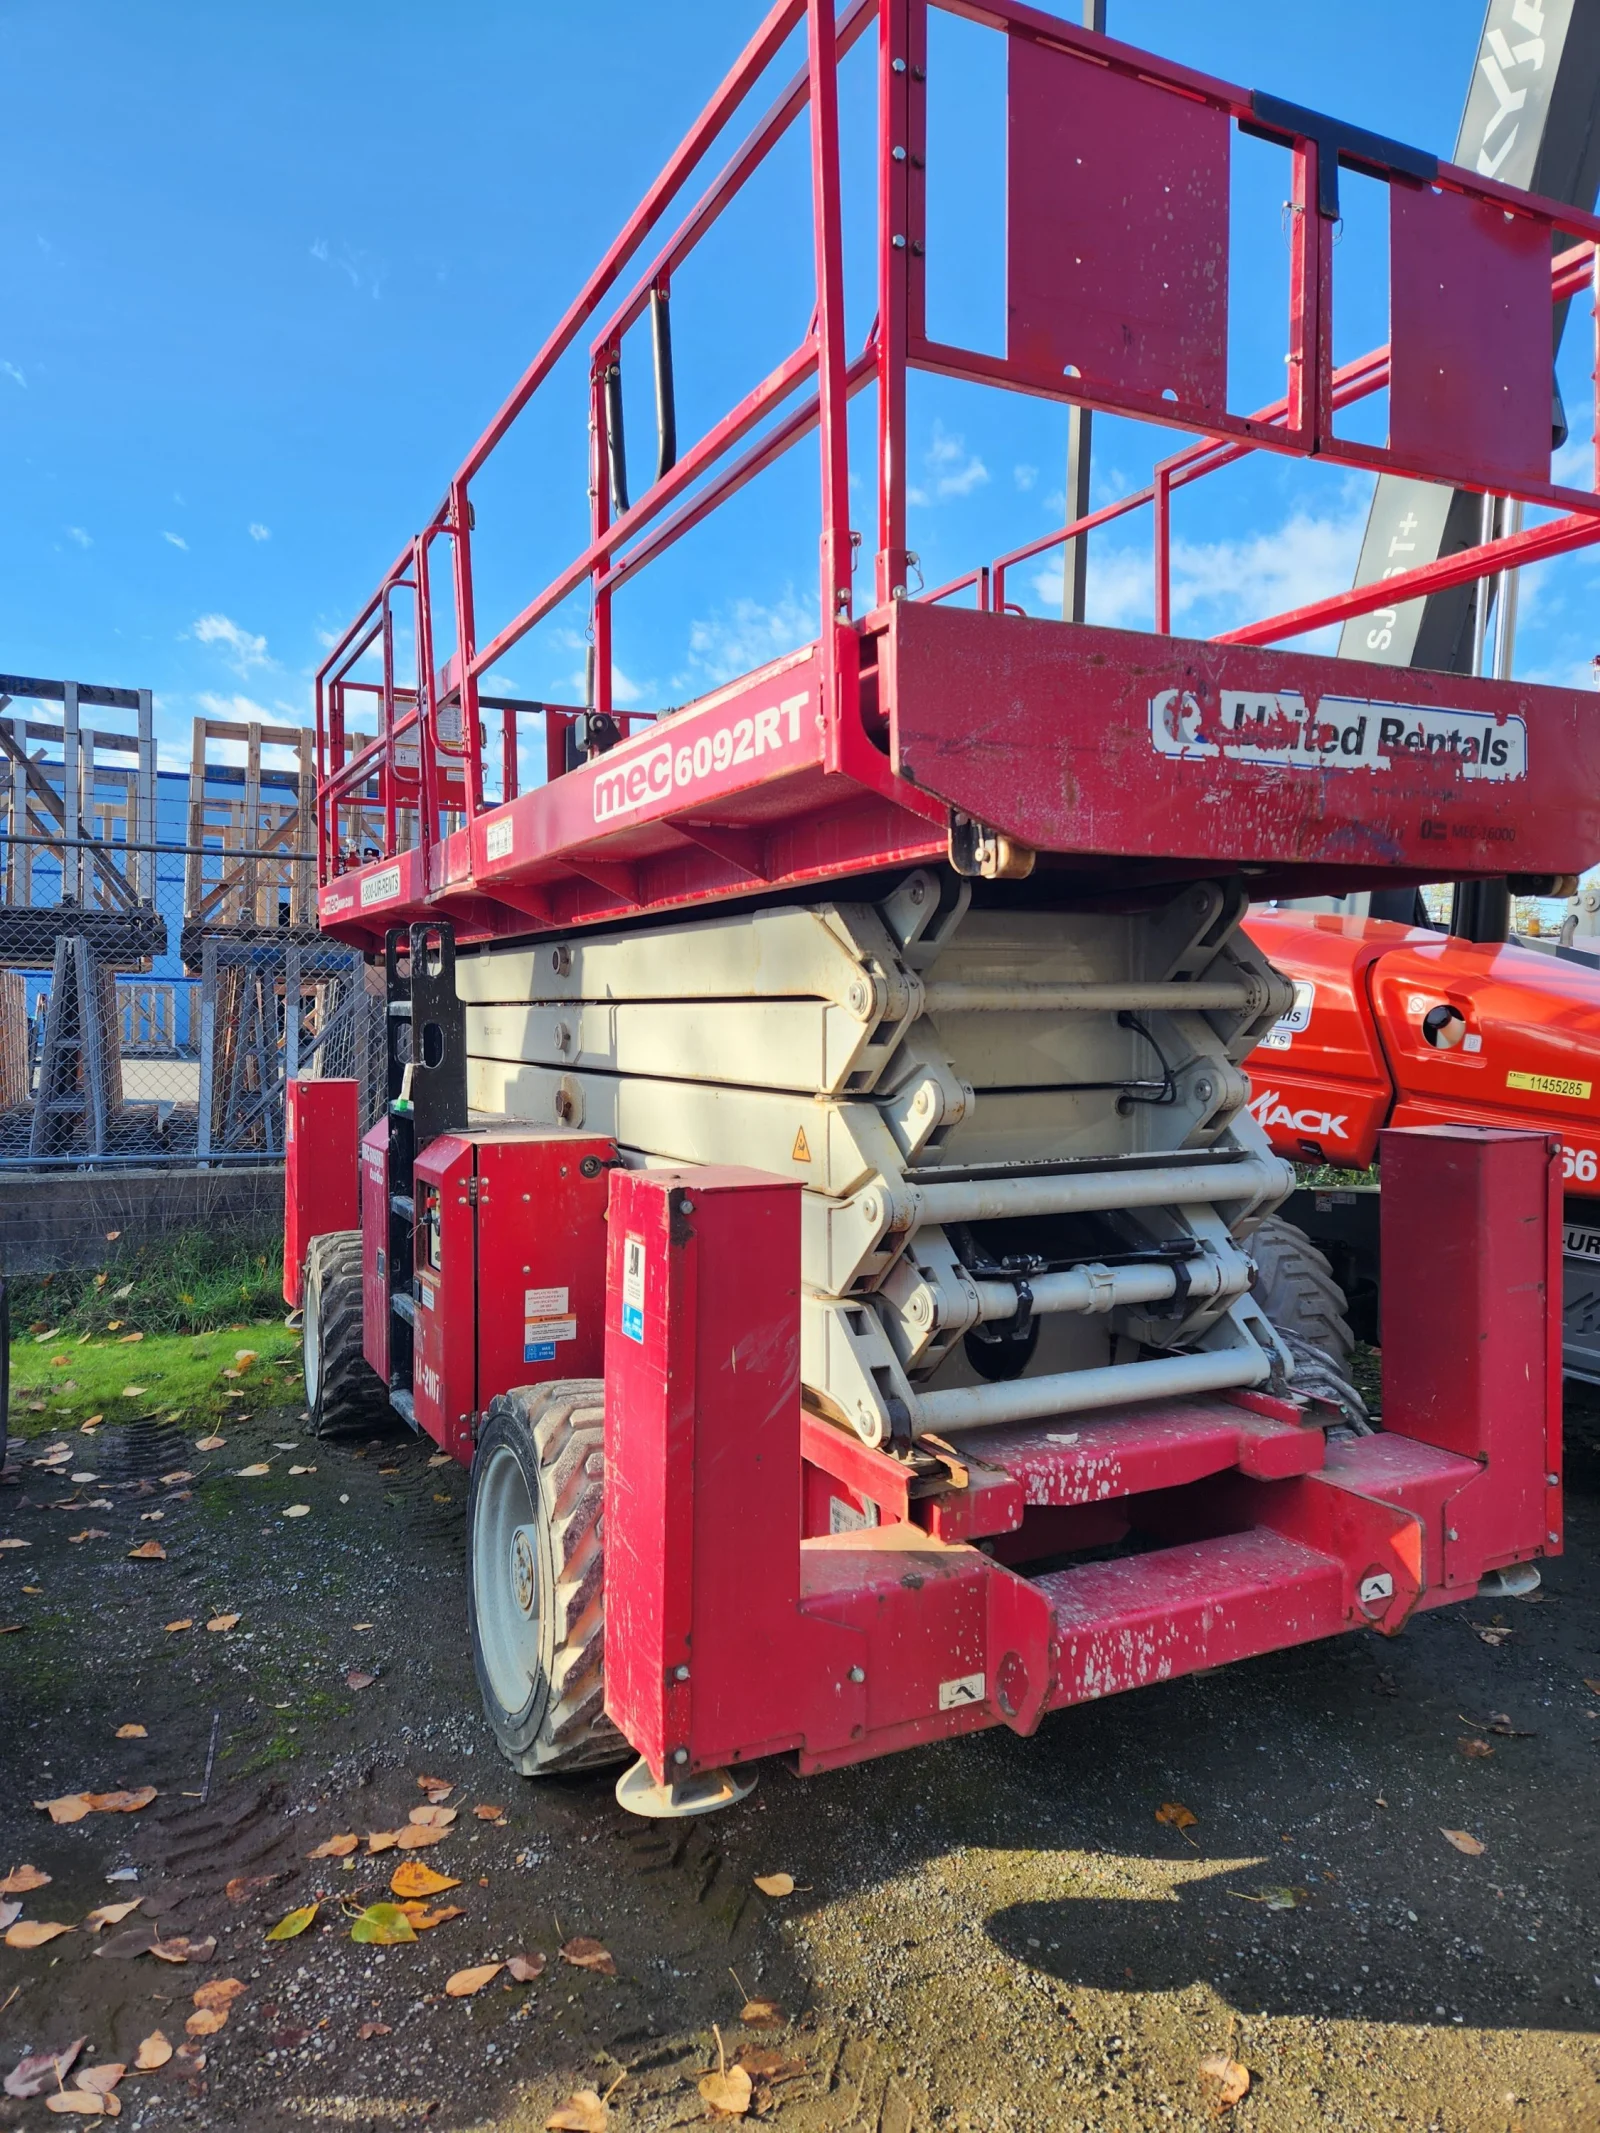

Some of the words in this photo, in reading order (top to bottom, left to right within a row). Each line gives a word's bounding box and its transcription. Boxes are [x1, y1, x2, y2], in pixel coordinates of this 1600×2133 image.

[595, 751, 672, 818] mec
[674, 691, 809, 787] 6092RT
[1530, 1076, 1583, 1096] 11455285
